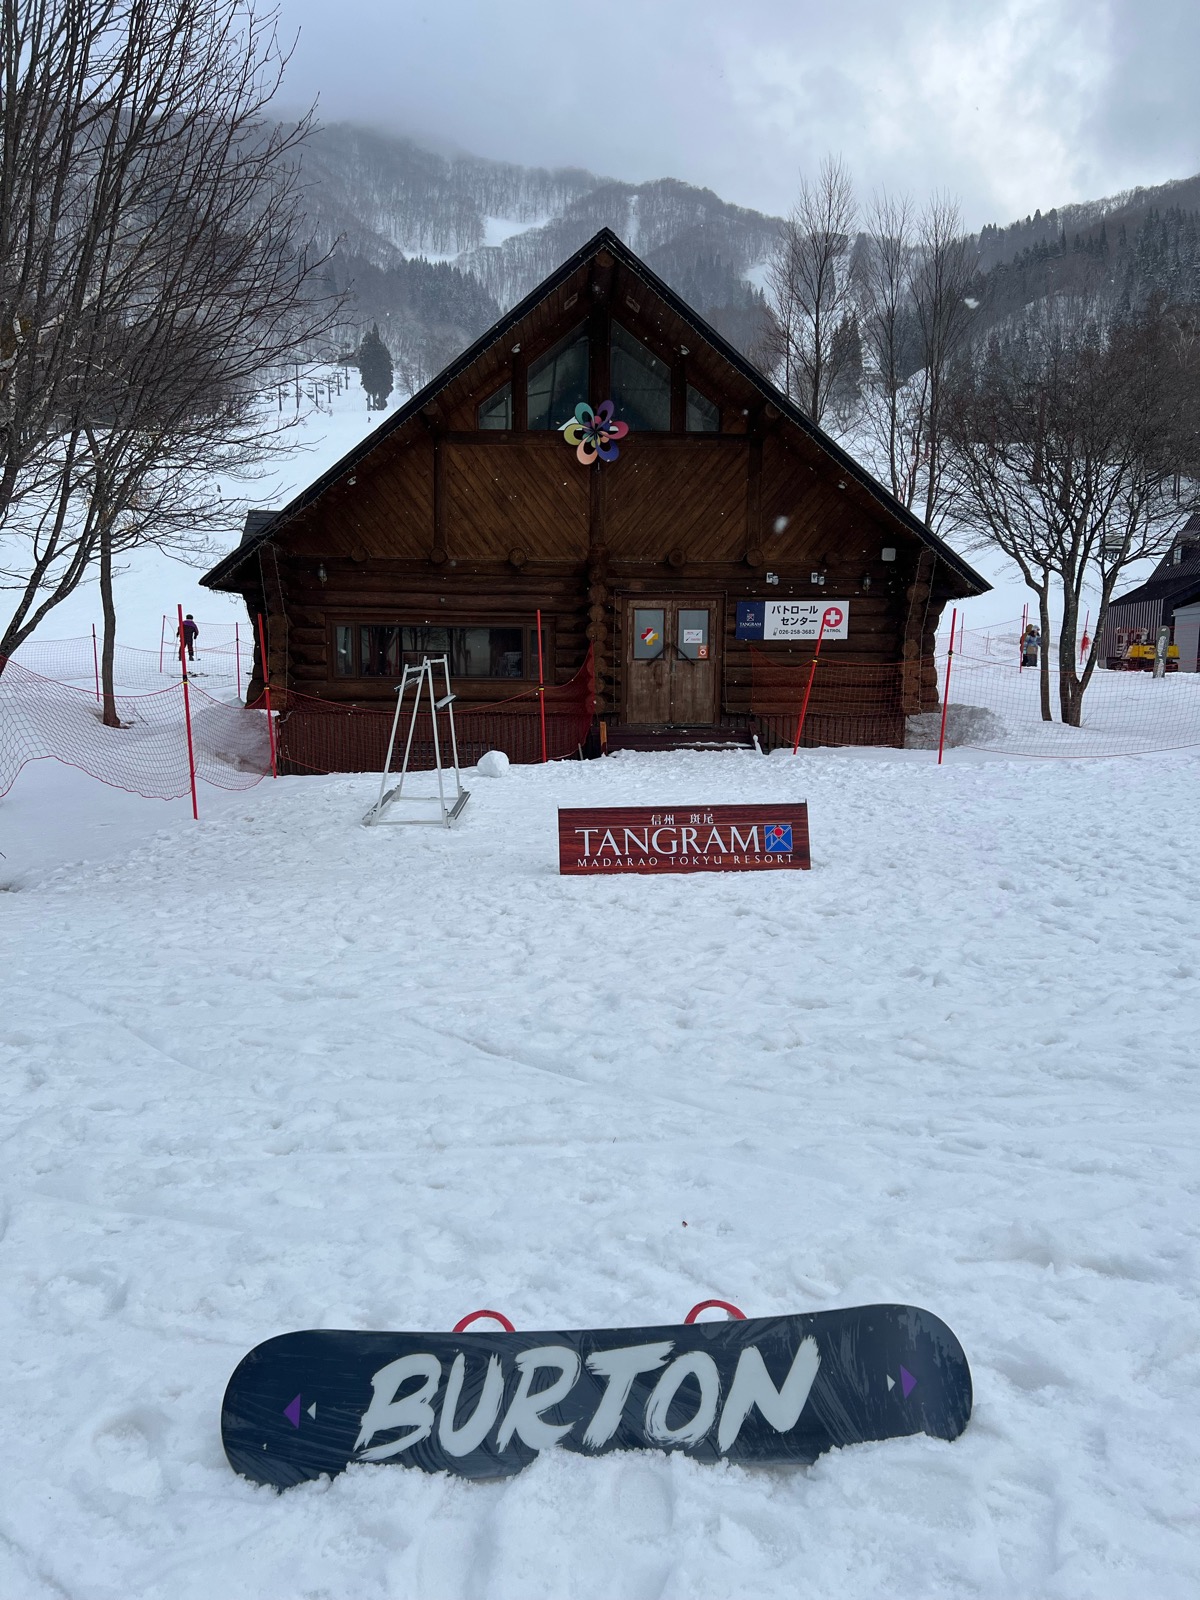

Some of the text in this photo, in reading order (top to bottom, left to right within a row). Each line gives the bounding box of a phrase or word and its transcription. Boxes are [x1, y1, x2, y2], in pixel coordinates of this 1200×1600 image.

[781, 616, 818, 626] センター
[651, 813, 714, 826] 信州 斑尾
[574, 826, 761, 857] TANGRAM
[577, 854, 794, 867] MADARAO TOKYU RESORT
[352, 1334, 822, 1462] BURTON
